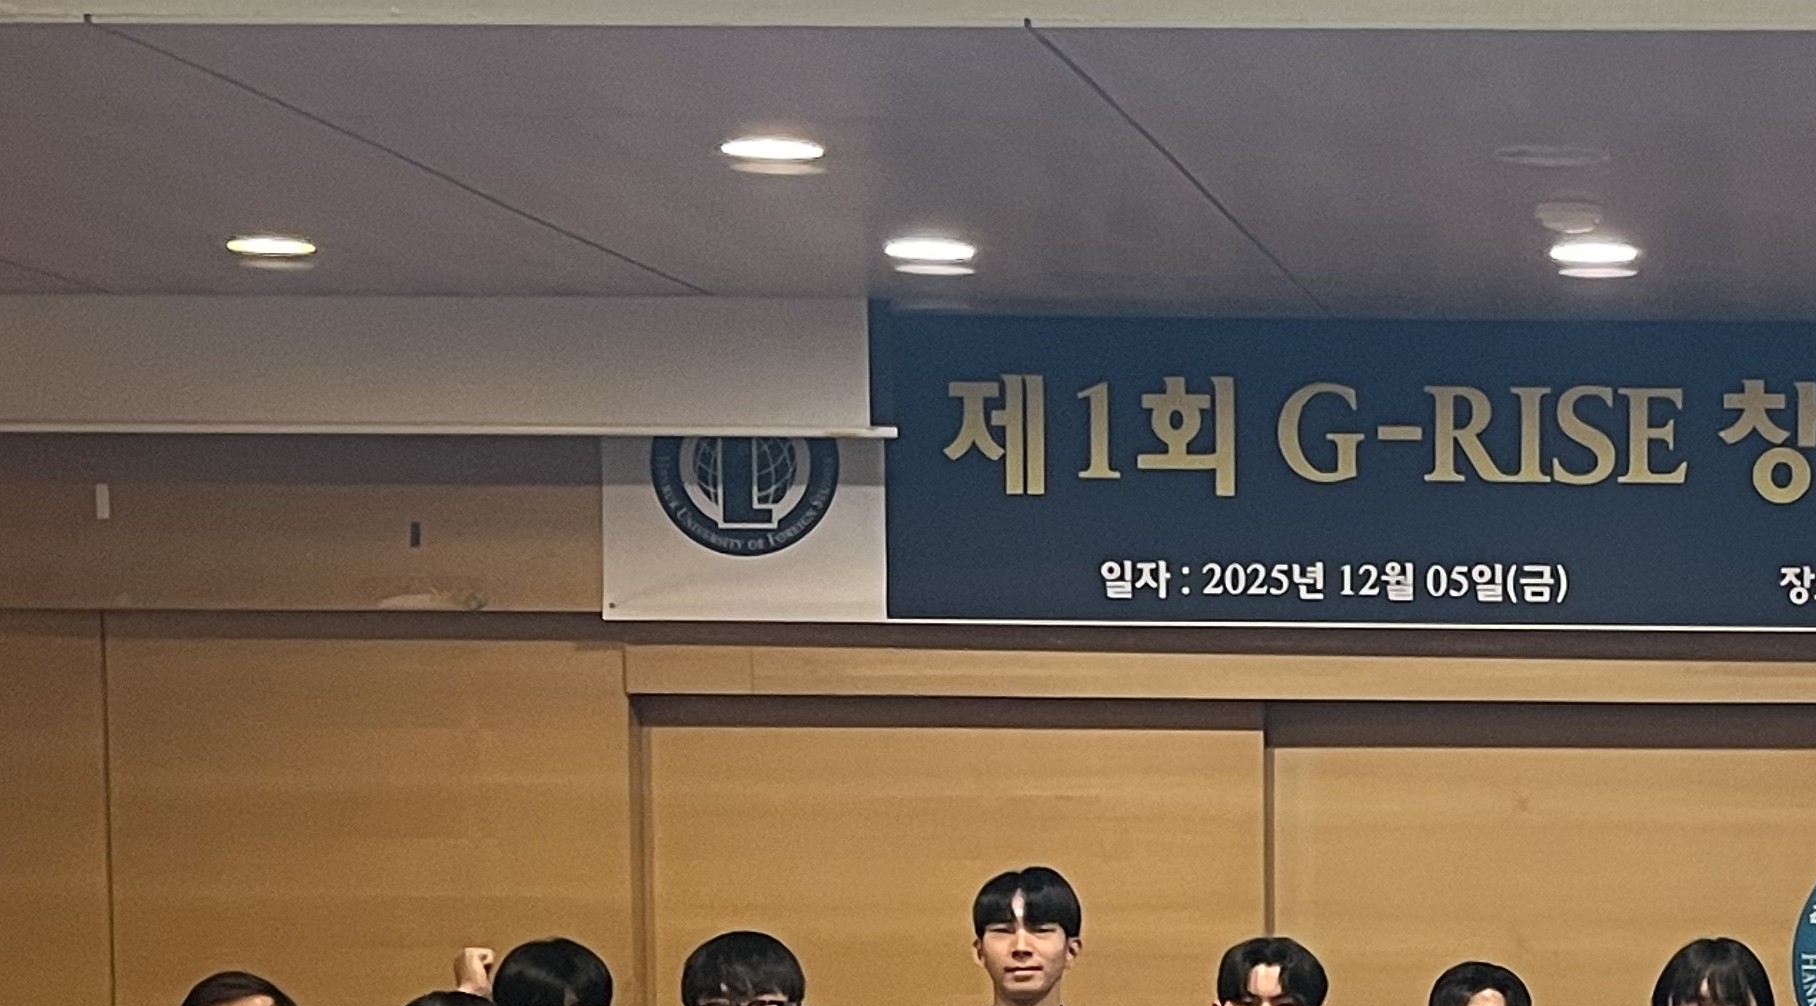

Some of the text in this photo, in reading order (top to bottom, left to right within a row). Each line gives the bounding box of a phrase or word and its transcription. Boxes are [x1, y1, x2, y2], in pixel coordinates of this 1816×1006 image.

[1277, 381, 1688, 487] G-RISE
[1100, 560, 1170, 599] 일자
[1202, 562, 1325, 600] 2025년
[1340, 562, 1414, 601] 12월
[1426, 563, 1568, 604] 05일(금)
